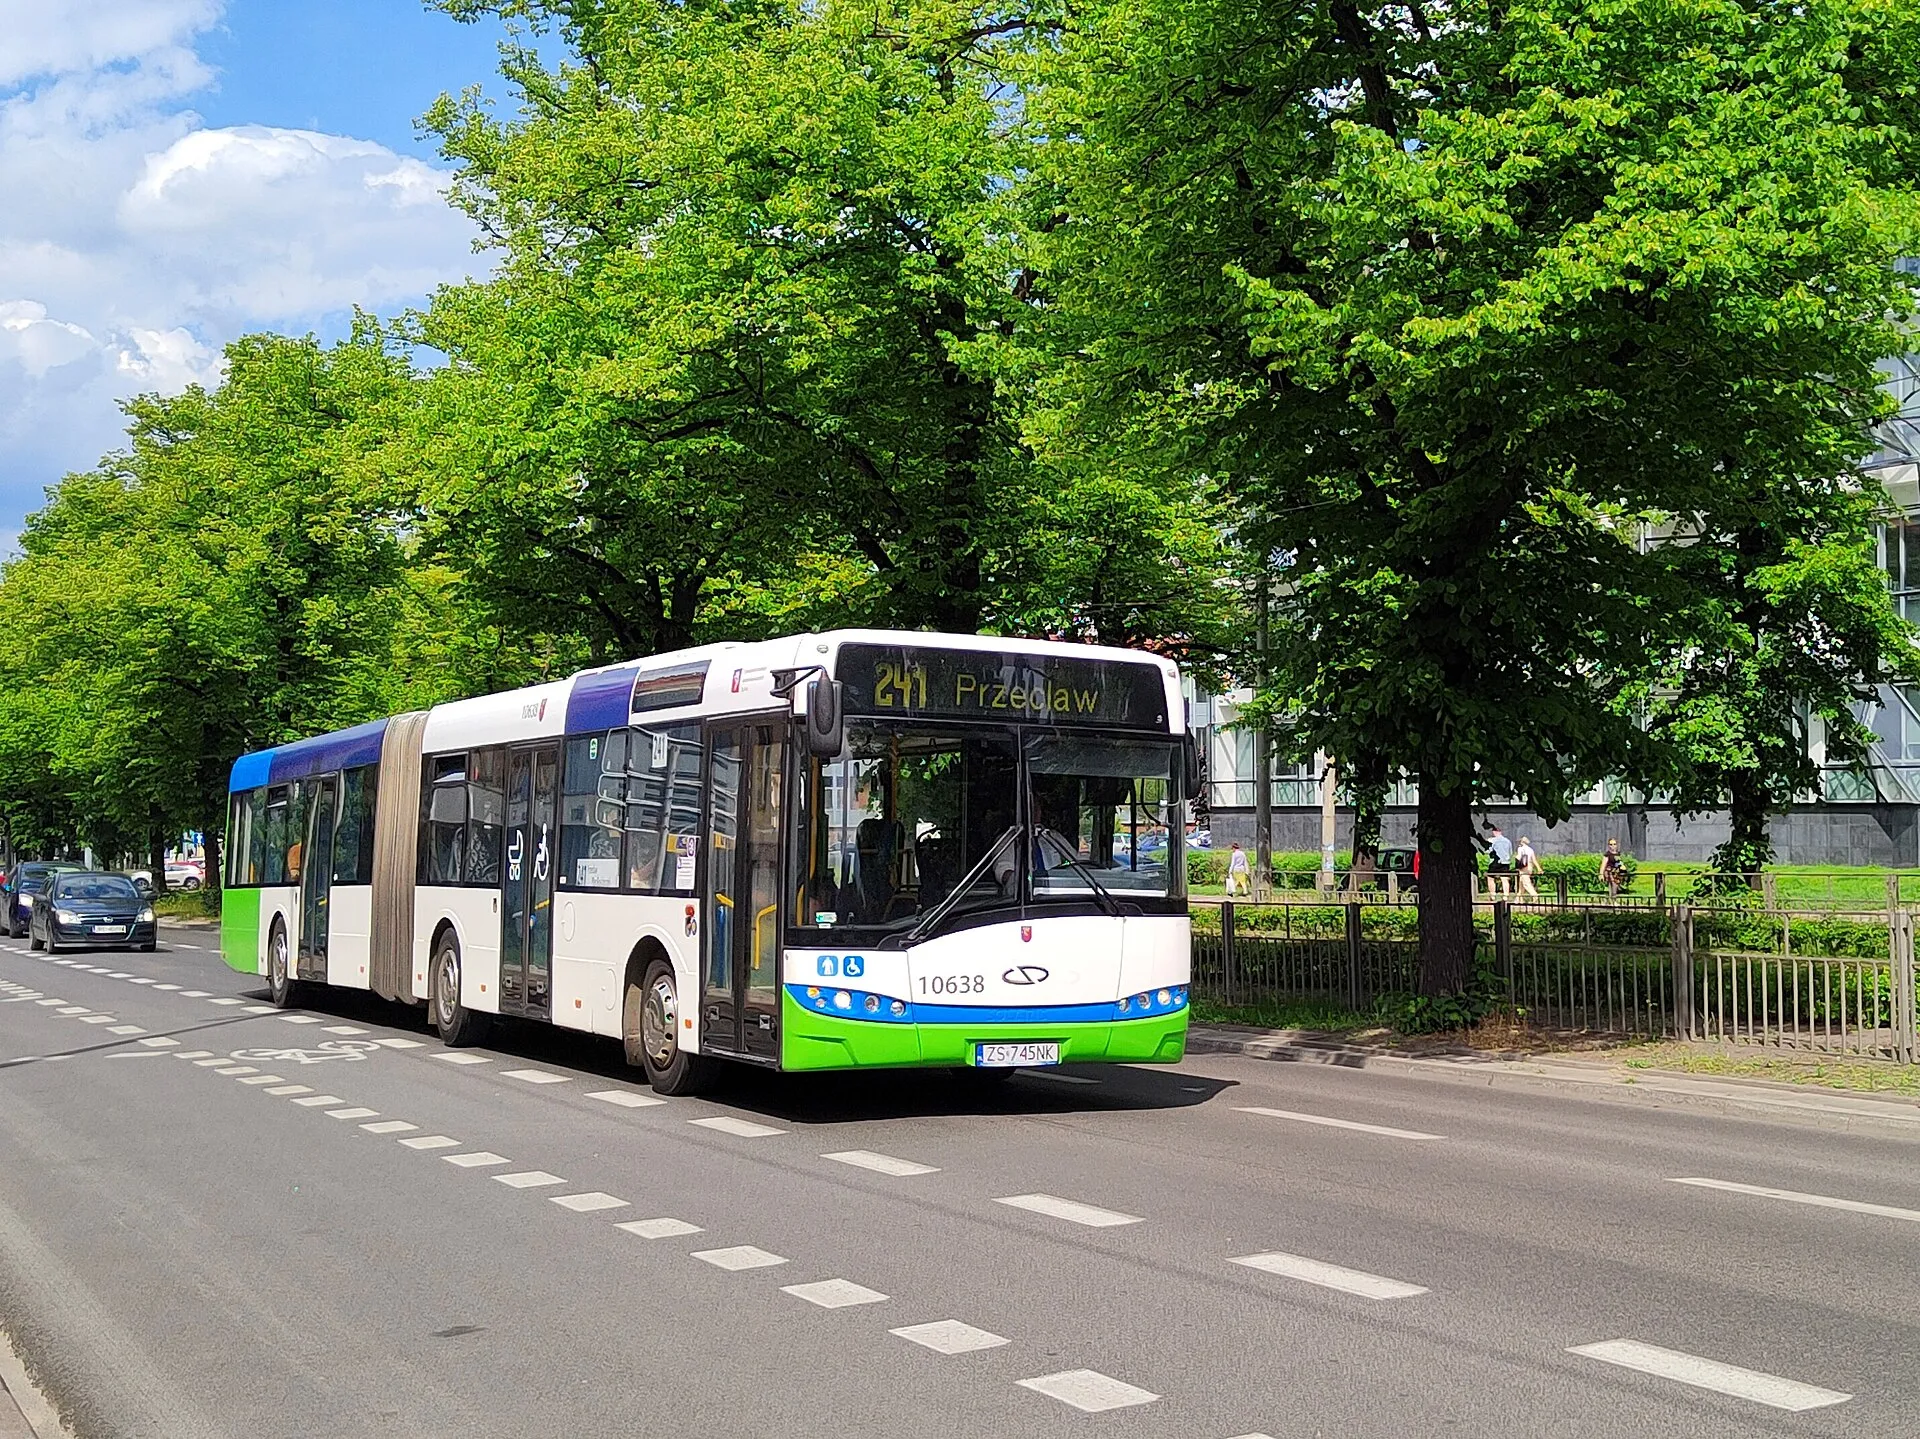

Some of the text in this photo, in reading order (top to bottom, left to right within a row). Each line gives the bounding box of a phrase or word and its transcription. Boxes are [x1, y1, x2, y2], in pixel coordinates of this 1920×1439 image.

[874, 662, 927, 709] 241
[919, 975, 985, 995] 10638
[987, 1046, 1005, 1062] ZS
[1010, 1044, 1054, 1061] 745NK
